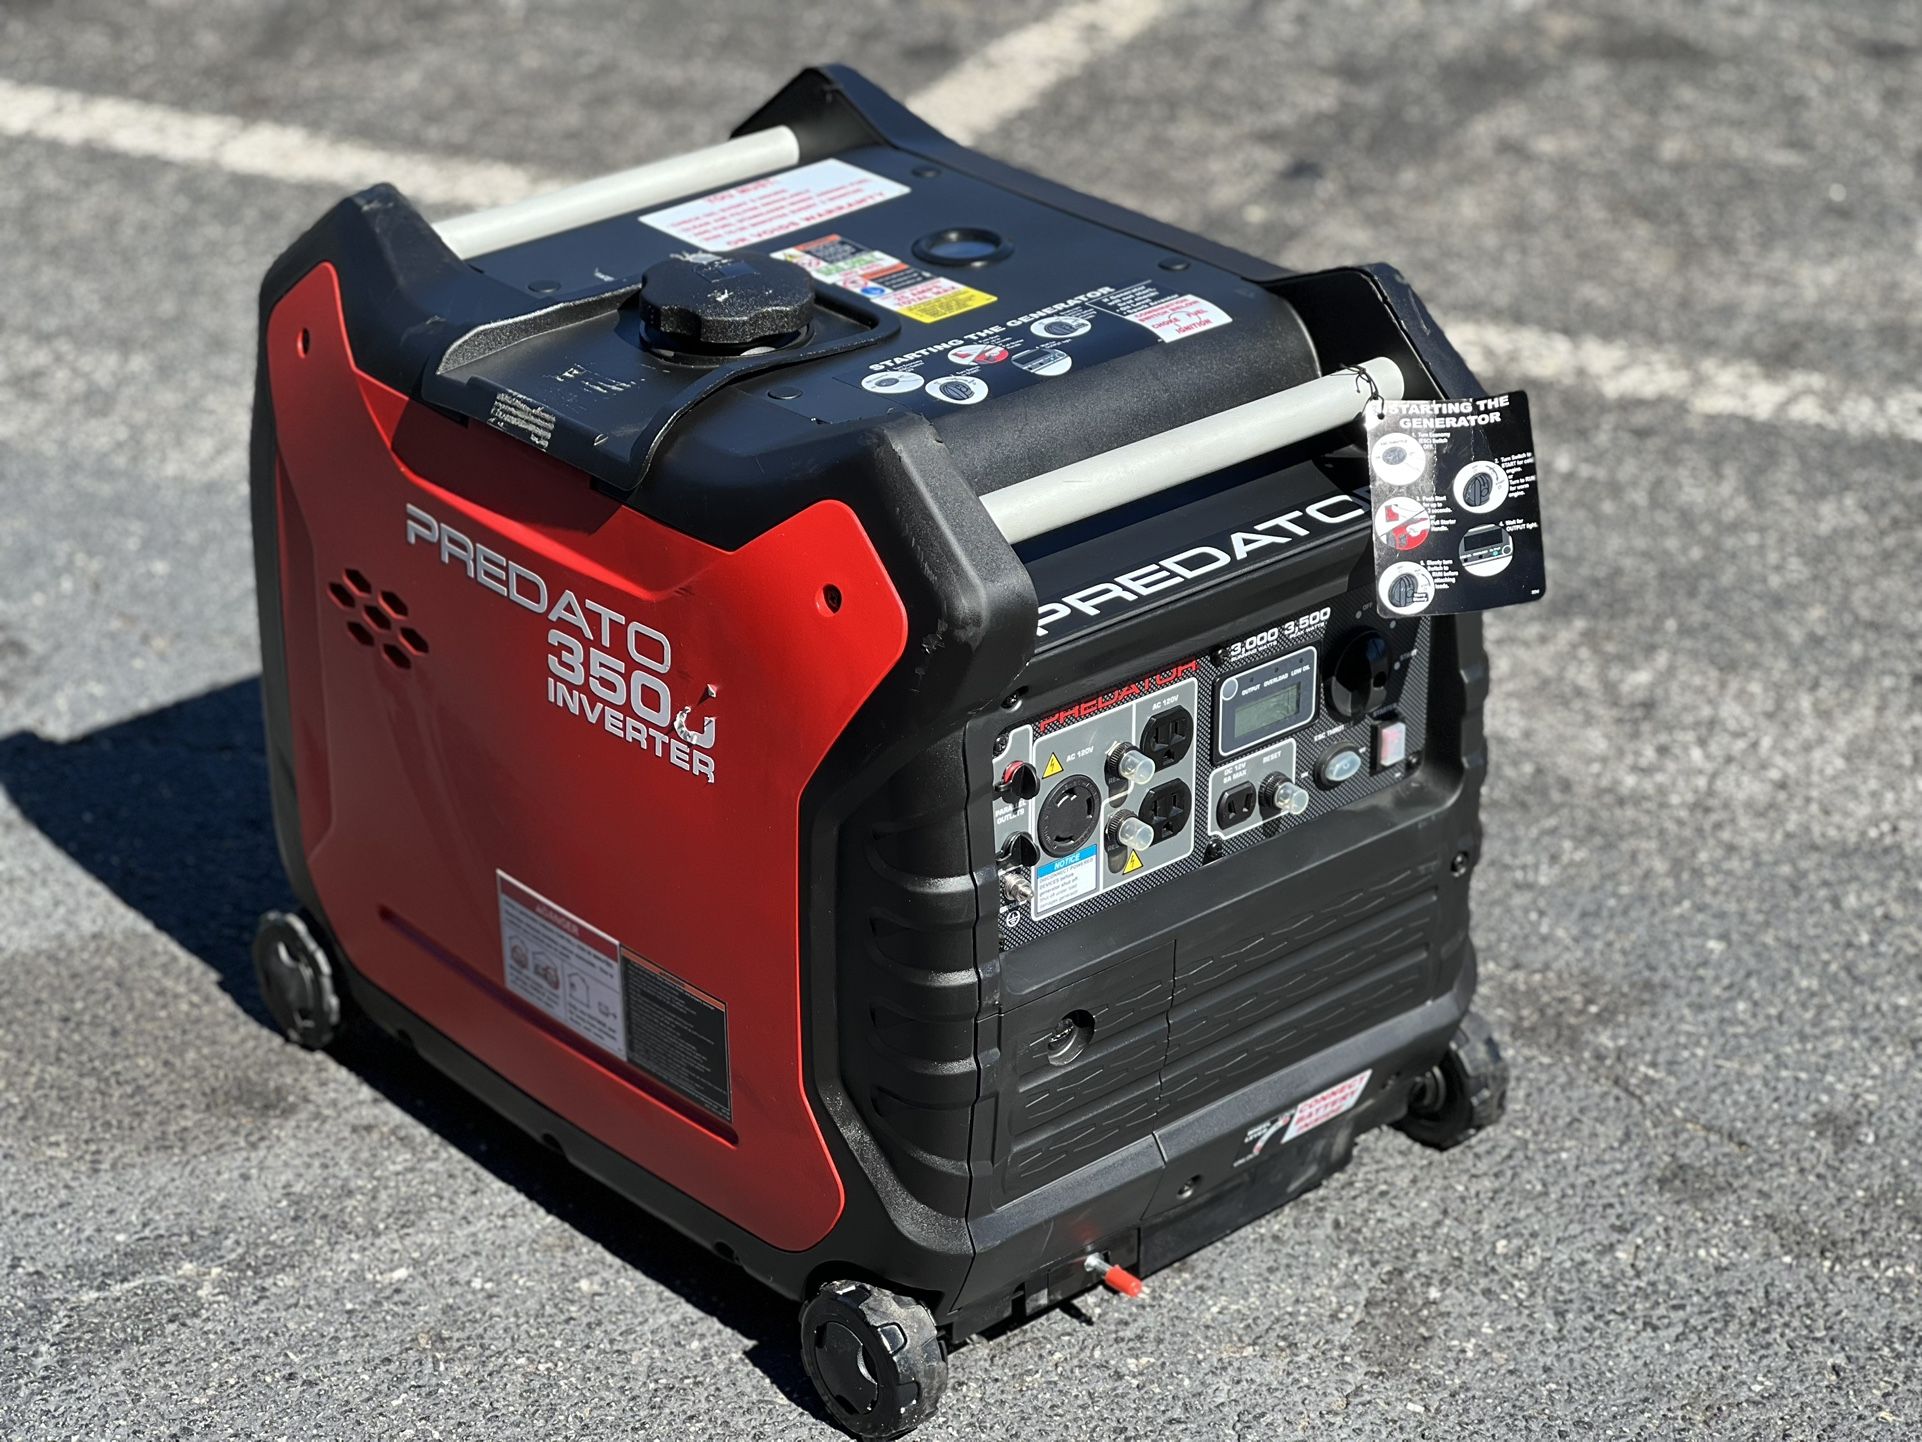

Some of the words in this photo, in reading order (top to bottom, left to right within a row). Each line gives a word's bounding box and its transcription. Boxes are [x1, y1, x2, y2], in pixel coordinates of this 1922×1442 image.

[1186, 308, 1208, 319] FUEL
[868, 338, 965, 371] STARTING
[963, 324, 1006, 341] THE
[1005, 285, 1116, 328] GENERATOR
[1152, 316, 1181, 330] CHOKE
[1175, 318, 1213, 334] IGNITION
[1388, 401, 1473, 415] STARTING
[1475, 394, 1510, 411] THE
[1399, 411, 1502, 429] GENERATOR
[1230, 627, 1278, 656] 3,000
[1284, 606, 1331, 636] 3,500
[1241, 683, 1261, 696] OUTPUT
[1263, 672, 1289, 688] OVERLOAD
[1290, 667, 1303, 677] LOW
[1302, 664, 1311, 672] OIL
[1152, 700, 1162, 711] AC
[1162, 694, 1180, 706] 120V
[547, 677, 716, 784] INVERTER
[1065, 752, 1076, 763] AC
[1076, 745, 1094, 758] 120V
[1262, 750, 1282, 764] RESET
[1224, 767, 1233, 776] DC
[1234, 762, 1247, 771] 12V
[1232, 769, 1248, 781] MAX
[1054, 852, 1081, 870] NOTICE
[1298, 1075, 1366, 1114] CONNECT
[1295, 1088, 1357, 1126] BATTERY
